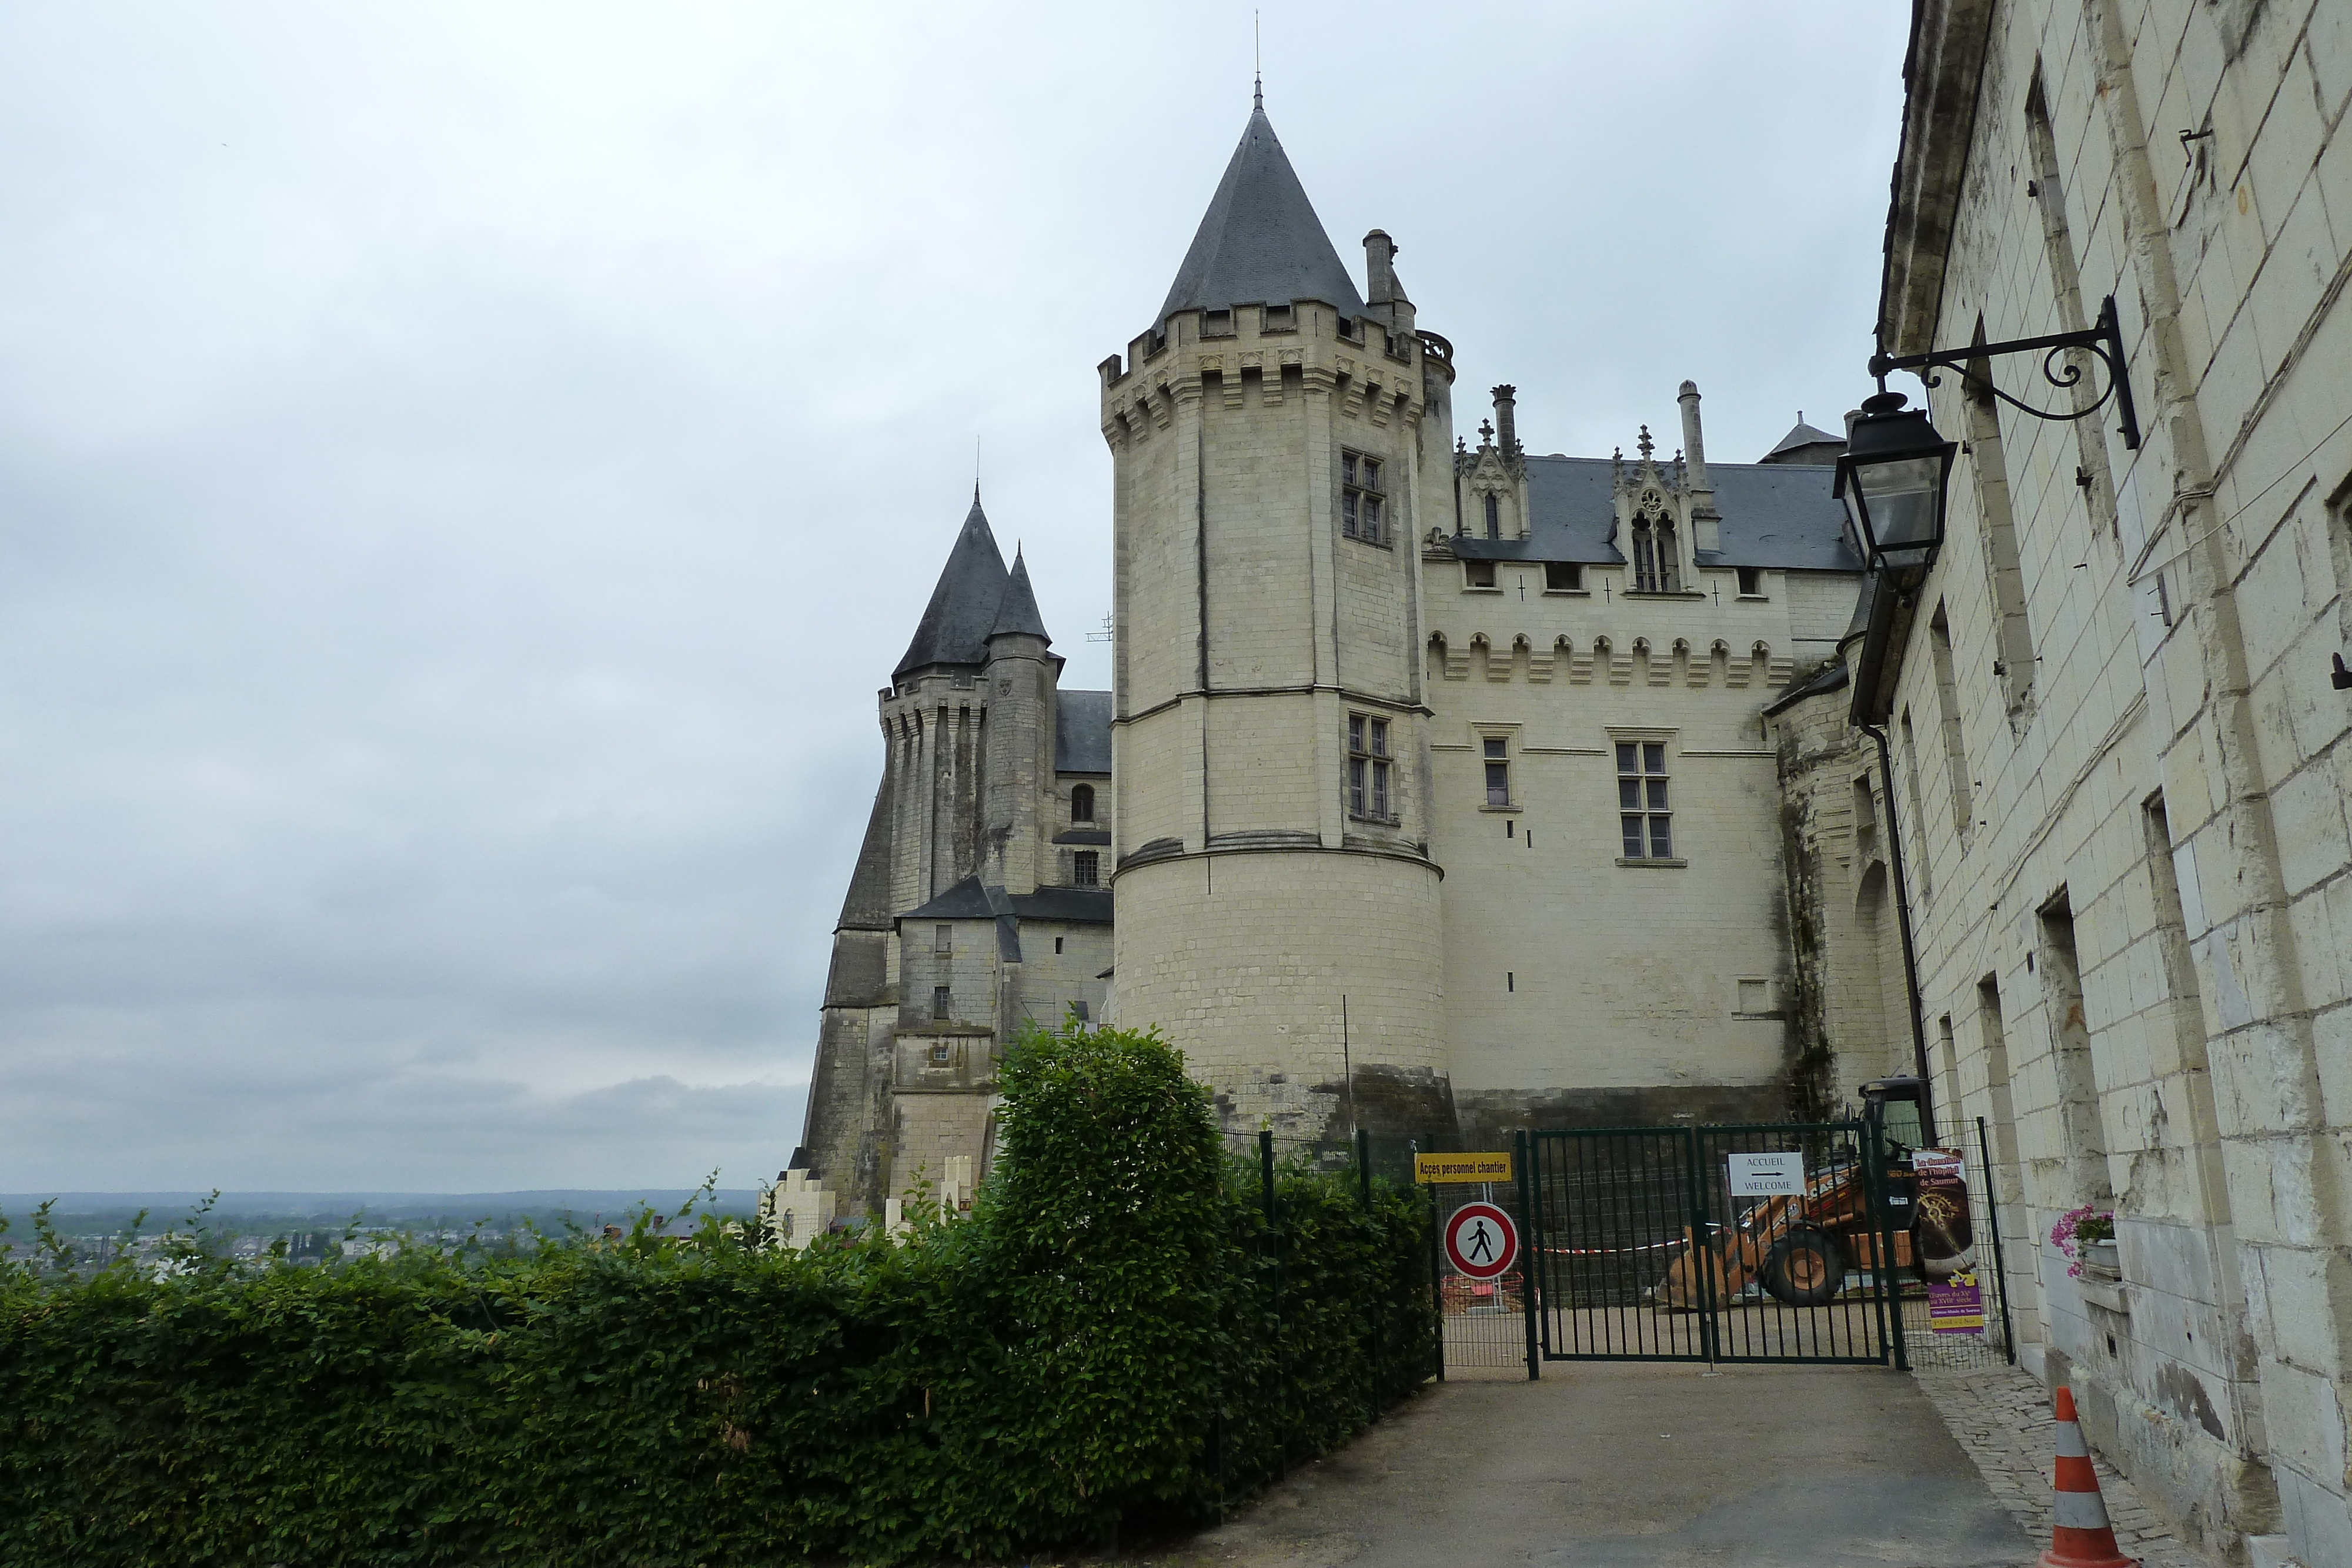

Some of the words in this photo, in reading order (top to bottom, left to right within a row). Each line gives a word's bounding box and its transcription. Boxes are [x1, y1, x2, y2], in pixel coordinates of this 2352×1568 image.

[1747, 1158, 1785, 1166] ACCUEIL
[1420, 1162, 1439, 1175] Accès
[1442, 1161, 1475, 1177] personnel
[1478, 1161, 1506, 1173] chantier
[1745, 1181, 1792, 1190] WELCOME
